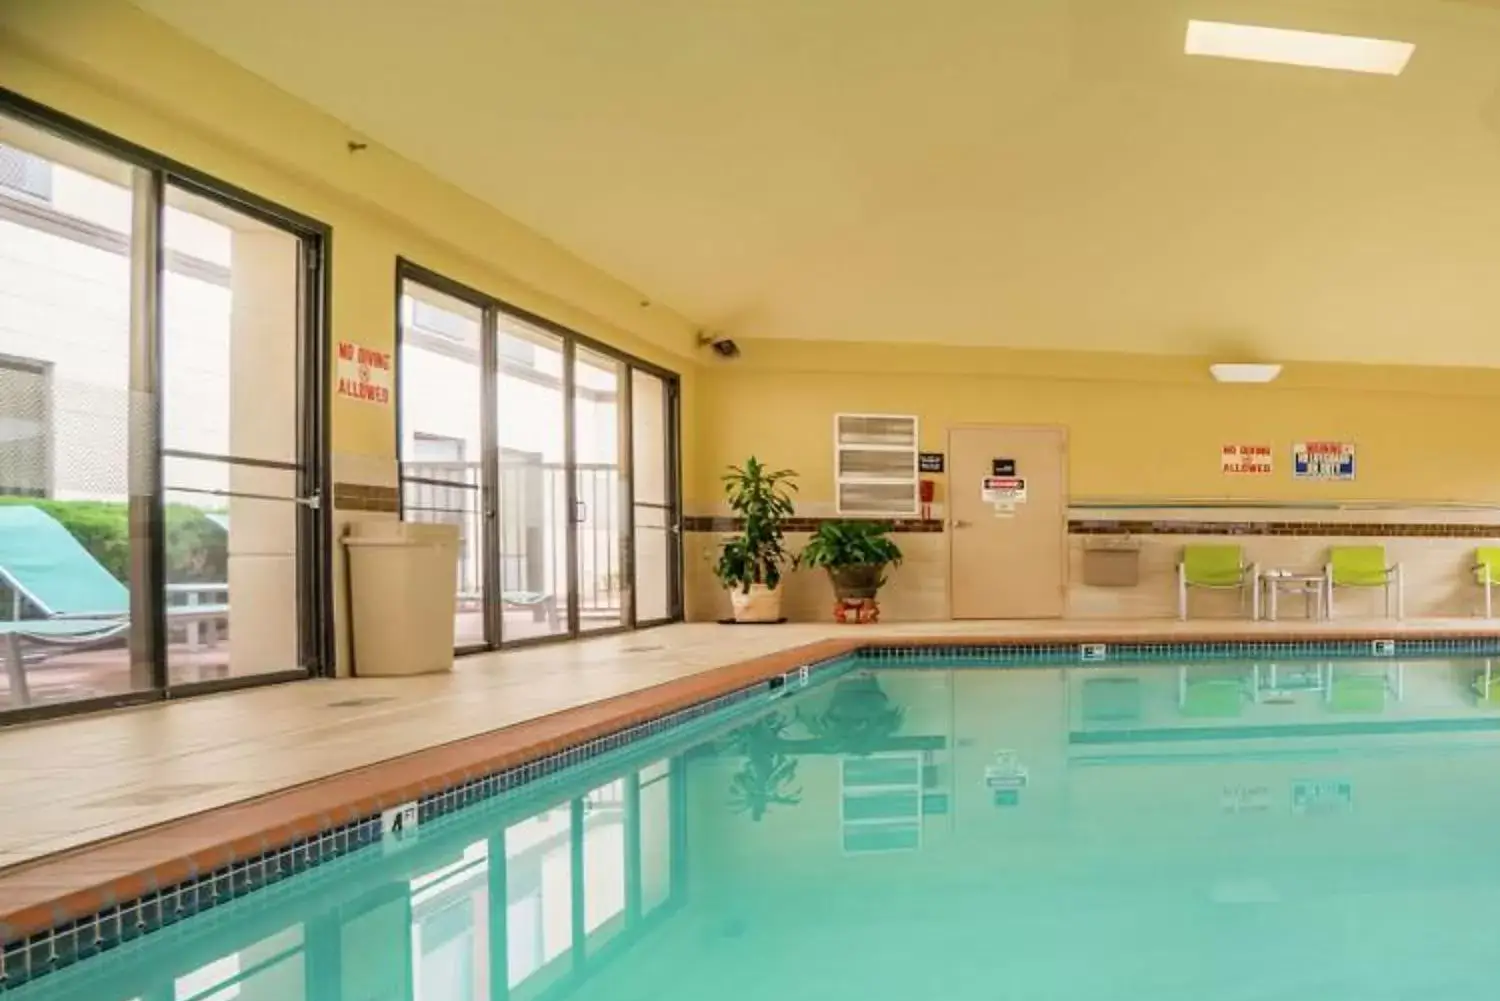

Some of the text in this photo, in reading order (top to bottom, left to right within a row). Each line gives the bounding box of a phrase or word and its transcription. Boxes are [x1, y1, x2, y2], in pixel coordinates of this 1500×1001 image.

[338, 342, 391, 371] NO DIVING
[337, 377, 389, 404] ALLOWED
[1223, 463, 1271, 473] ALLOWED
